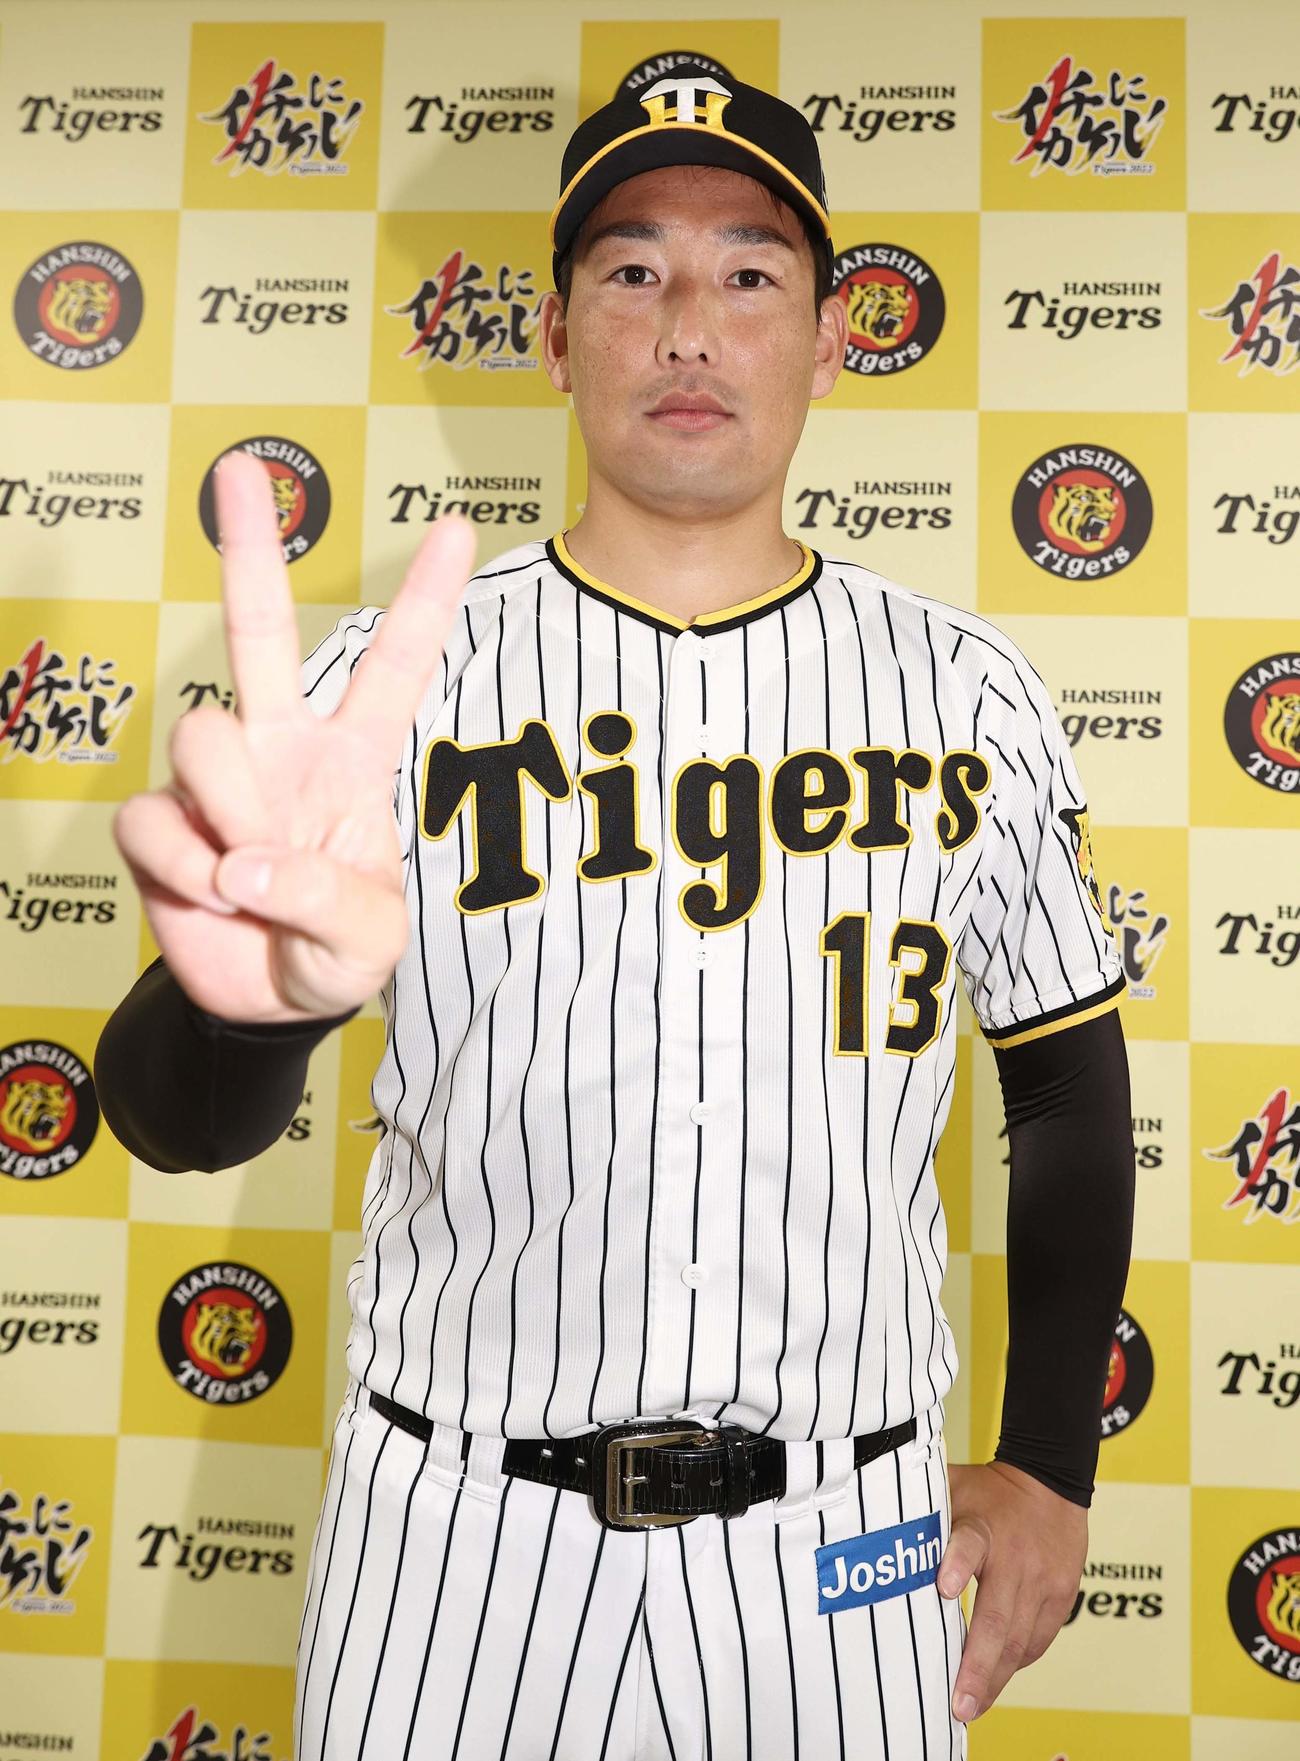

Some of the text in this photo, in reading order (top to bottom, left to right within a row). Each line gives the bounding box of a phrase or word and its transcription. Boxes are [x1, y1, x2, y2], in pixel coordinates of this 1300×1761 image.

[72, 87, 164, 101] HANSHIN
[461, 87, 555, 101] HANSHIN
[860, 86, 956, 100] HANSHIN
[20, 95, 163, 142] Tigers
[405, 96, 555, 143] Tigers
[803, 94, 957, 142] Tigers
[30, 245, 131, 283] HANSHIN
[256, 278, 349, 293] HANSHIN
[1063, 282, 1162, 297] HANSHIN
[200, 285, 349, 334] Tigers
[1004, 288, 1162, 339] Tigers
[31, 331, 123, 368] Tigers
[48, 471, 143, 487] HANSHIN
[446, 476, 541, 491] HANSHIN
[1027, 448, 1137, 489] HANSHIN
[854, 481, 951, 496] HANSHIN
[796, 487, 952, 539] Tigers
[1033, 540, 1131, 579] Tigers
[1062, 689, 1162, 704] HANSHIN
[419, 710, 992, 932] Tigers
[27, 873, 117, 889] HANSHIN
[819, 911, 951, 1058] 13
[1, 1291, 101, 1309] HANSHIN
[172, 1266, 279, 1311] HANSHIN
[176, 1360, 270, 1404] Tigers
[198, 1516, 296, 1540] HANSHIN
[138, 1523, 295, 1582] Tigers
[821, 1532, 941, 1599] Joshin
